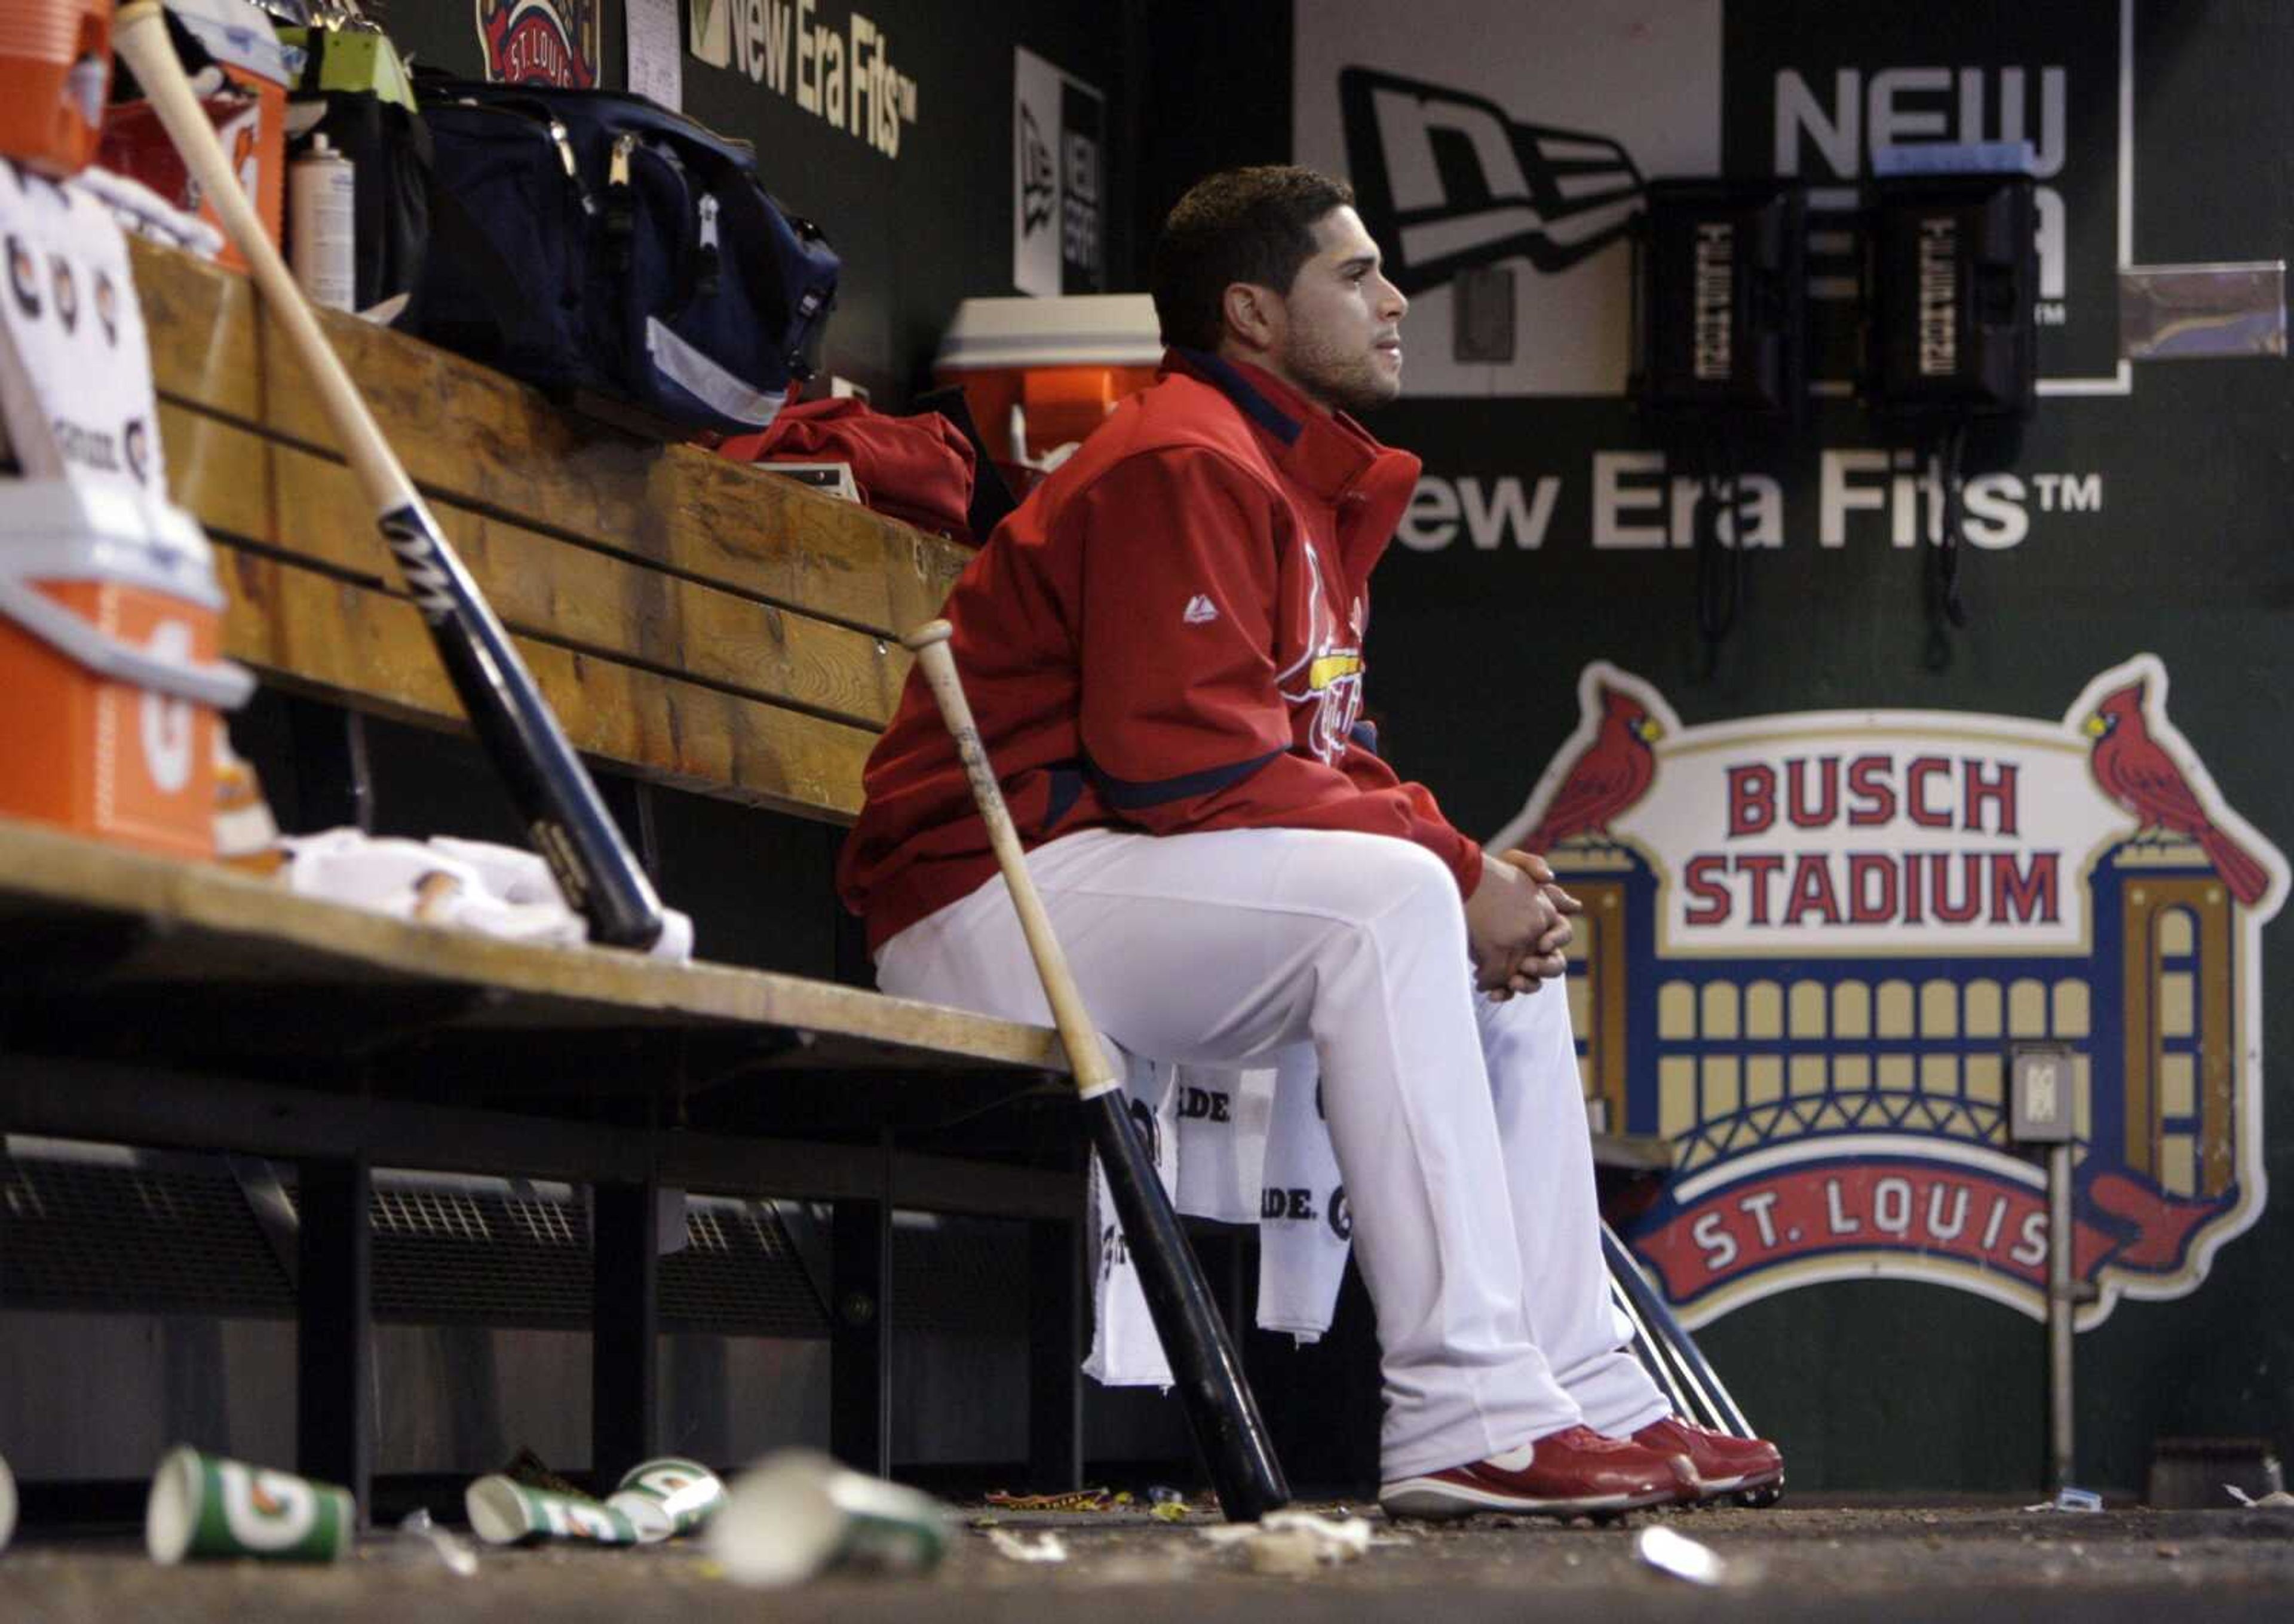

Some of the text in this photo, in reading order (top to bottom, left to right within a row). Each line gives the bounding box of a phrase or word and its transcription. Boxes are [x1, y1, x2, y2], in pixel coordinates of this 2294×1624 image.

[797, 0, 845, 129] Era
[1774, 66, 2066, 179] NEW
[1395, 475, 1561, 551] ew
[1592, 450, 1784, 549] Era
[1725, 755, 2020, 839] BUSCH
[1683, 851, 2062, 926] STADIUM
[1692, 1177, 2050, 1271] ST. LOUIS
